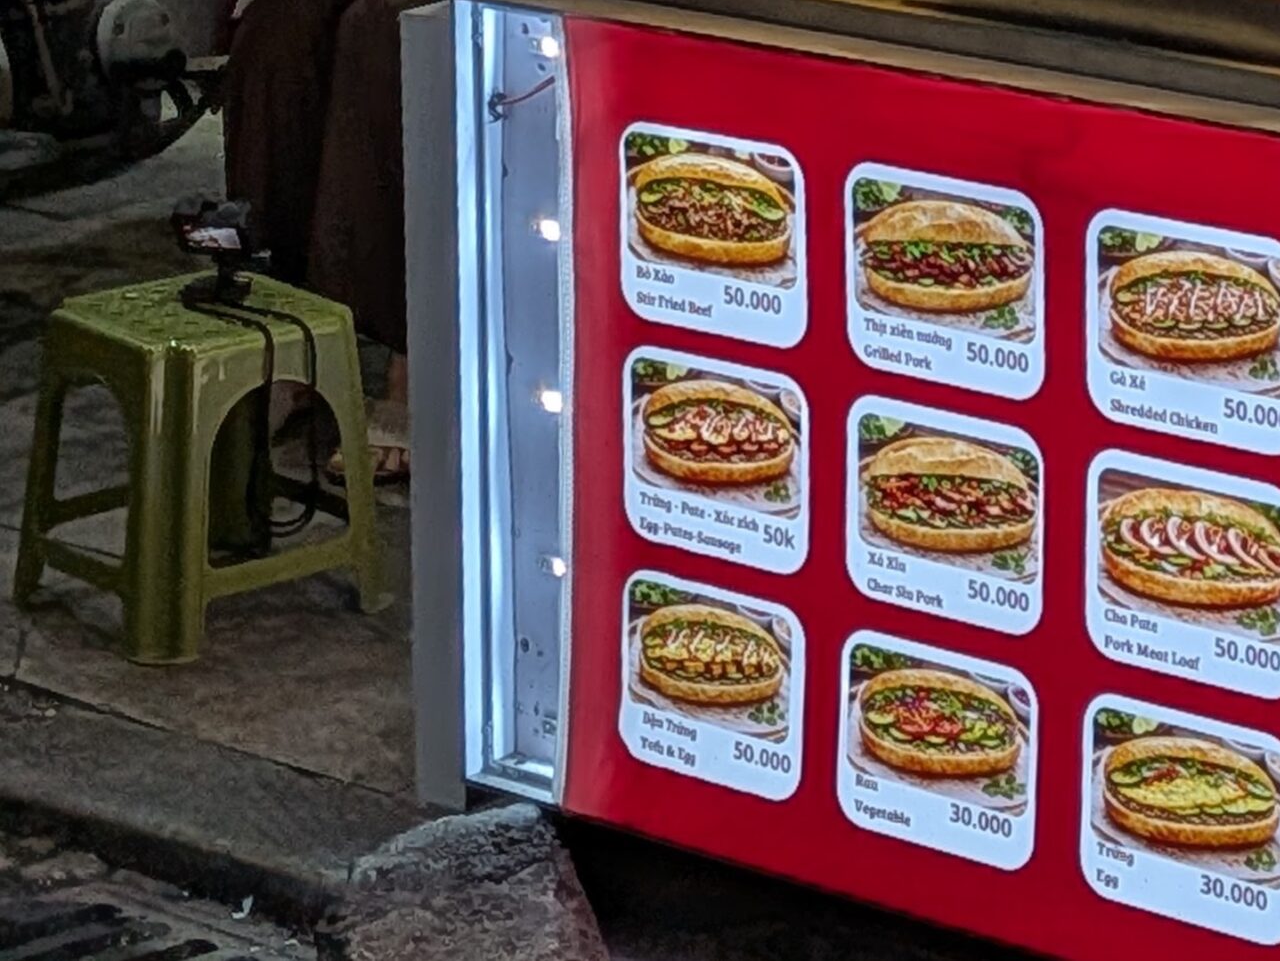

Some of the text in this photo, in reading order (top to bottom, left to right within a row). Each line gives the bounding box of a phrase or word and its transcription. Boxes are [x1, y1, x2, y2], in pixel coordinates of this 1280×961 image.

[636, 291, 714, 318] Stir Fried Beef
[723, 285, 782, 315] 50.000
[863, 344, 933, 371] Grilled Pork
[966, 341, 1029, 373] 50.000
[1110, 398, 1218, 435] Shredded Chicken
[681, 501, 705, 519] Pate
[916, 589, 944, 609] Pork
[967, 578, 1030, 612] 50.000
[1130, 613, 1159, 634] Pate
[1104, 634, 1200, 671] Pork Meat Loaf
[733, 741, 792, 774] 50.000
[854, 799, 911, 827] Vegetable
[949, 802, 1013, 838] 30.000
[1096, 868, 1119, 890] Egg
[1199, 874, 1268, 911] 30.000
